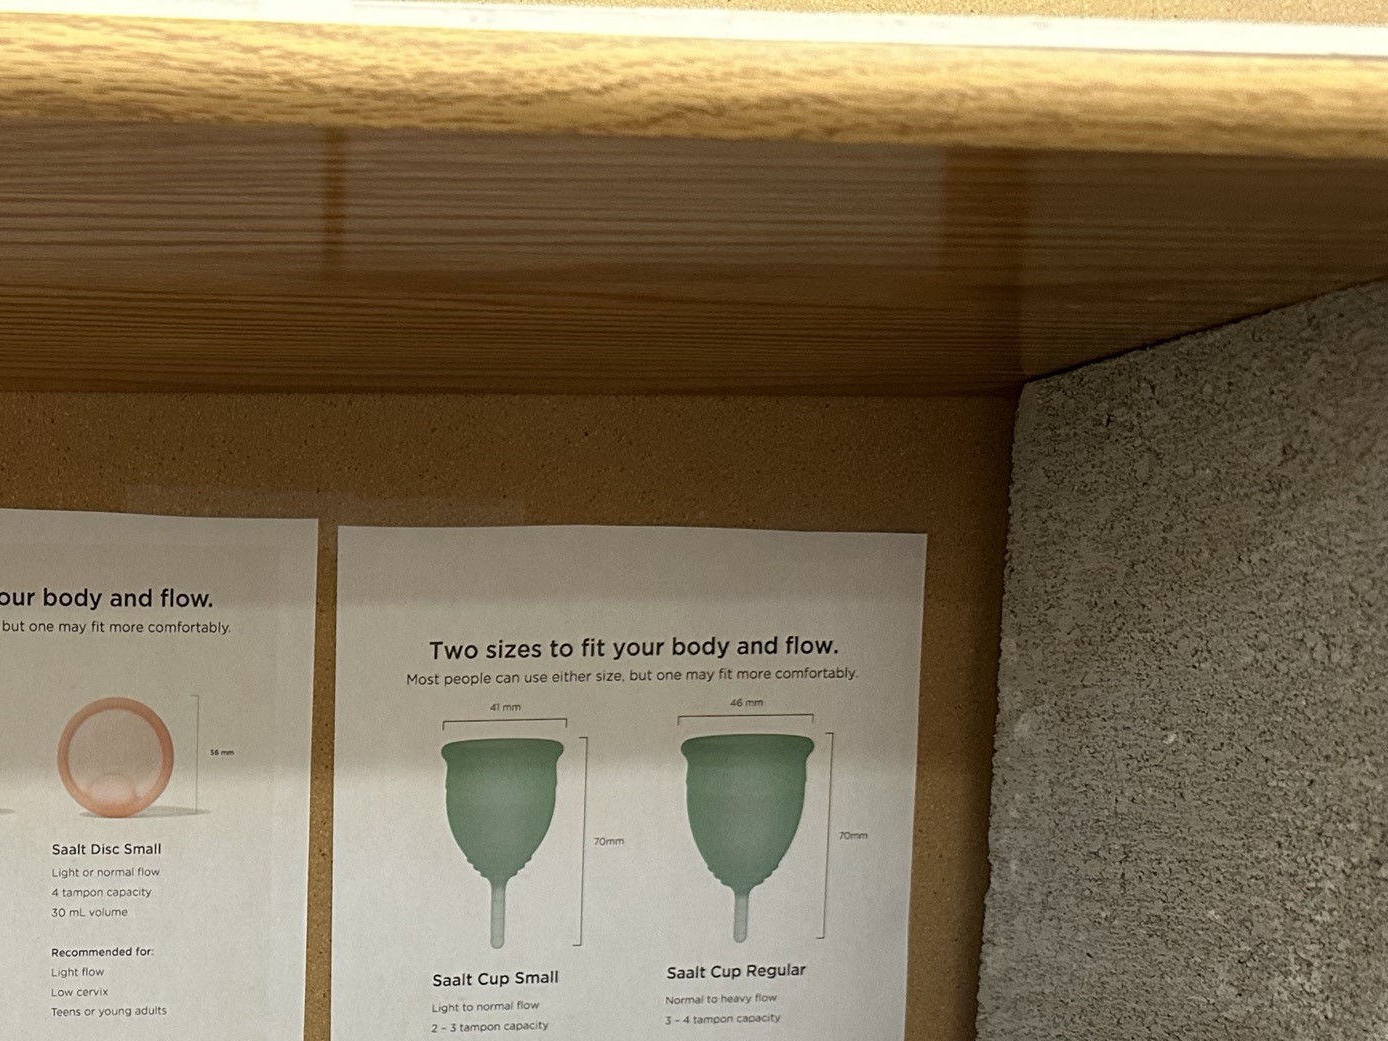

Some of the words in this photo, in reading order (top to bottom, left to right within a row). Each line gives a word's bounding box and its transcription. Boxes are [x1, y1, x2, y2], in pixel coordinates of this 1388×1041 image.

[44, 588, 102, 610] body
[110, 589, 152, 607] and
[161, 588, 212, 607] flow.
[3, 620, 25, 632] but
[29, 623, 54, 632] one
[59, 623, 87, 634] may
[92, 621, 104, 632] fit
[110, 624, 143, 632] more
[148, 621, 231, 635] comfortably.
[430, 642, 478, 659] Two
[486, 640, 541, 658] sizes
[550, 640, 573, 657] to
[582, 638, 605, 657] fit
[613, 642, 664, 660] your
[673, 637, 730, 659] body
[737, 636, 778, 655] and
[786, 636, 838, 654] flow.
[594, 837, 624, 846] 70mm
[840, 832, 868, 840] 70mm
[53, 844, 86, 855] Saalt
[91, 844, 119, 854] Disc
[124, 843, 161, 854] Small
[52, 947, 132, 957] Recommended
[136, 947, 153, 956] for:
[52, 968, 78, 978] Light
[82, 967, 104, 976] flow
[667, 966, 705, 979] Saalt
[711, 966, 741, 979] Cup
[747, 964, 806, 979] Regular
[433, 974, 472, 986] Saalt
[478, 973, 509, 987] Cup
[515, 971, 558, 984] Small
